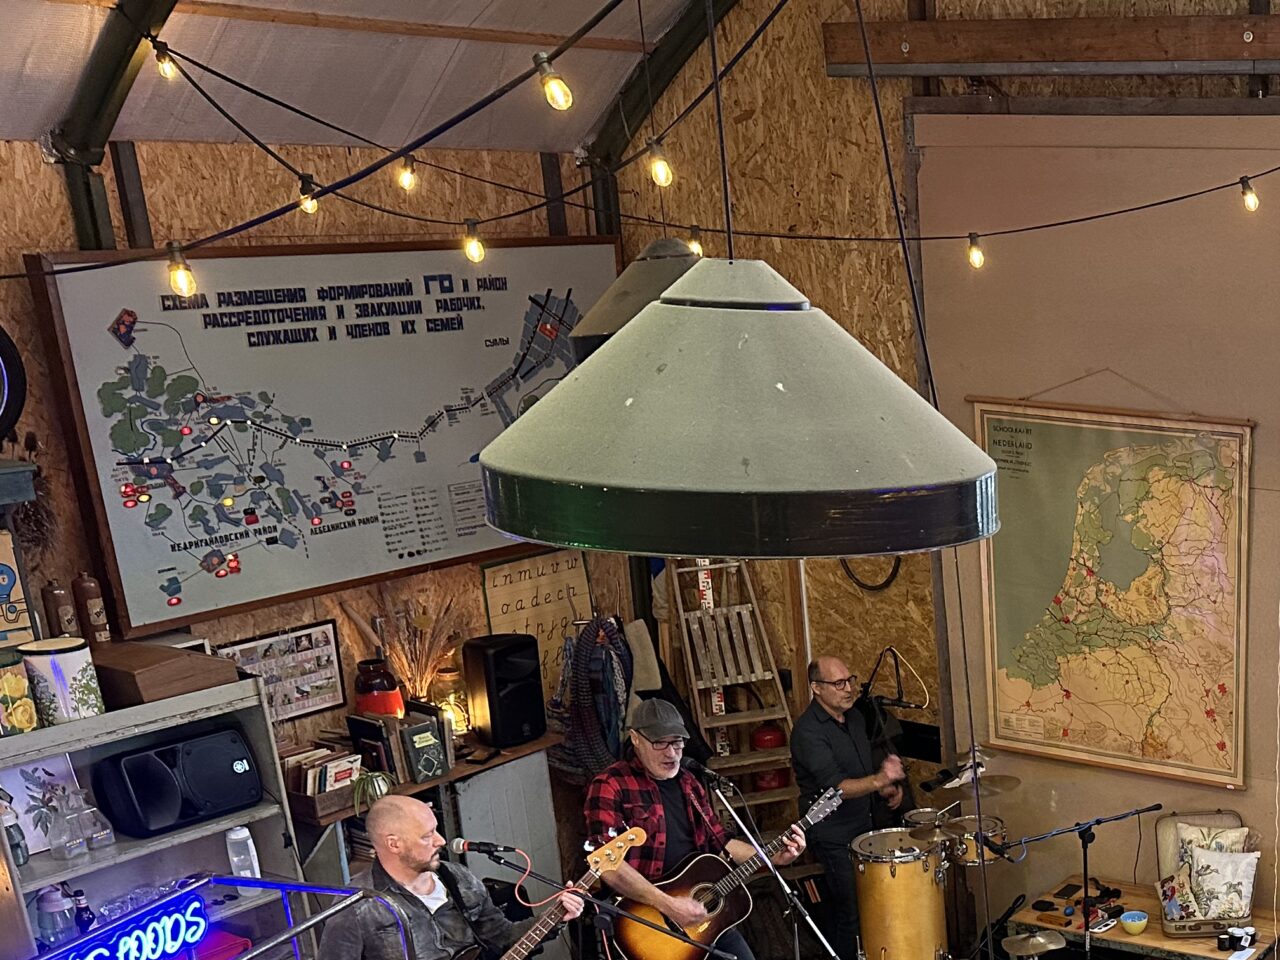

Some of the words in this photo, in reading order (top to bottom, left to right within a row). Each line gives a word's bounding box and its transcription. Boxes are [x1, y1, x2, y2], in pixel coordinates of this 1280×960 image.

[160, 294, 209, 312] СХЕМА
[217, 287, 307, 308] РАЗМЕЩЕНИЯ
[317, 278, 413, 301] ФОРМИРОВАНИЙ
[462, 279, 469, 292] И
[477, 274, 507, 292] РАЙОН
[202, 305, 327, 329] РАССРЕДОТОЧЕНИЯ
[336, 304, 345, 320] И
[354, 299, 423, 319] ЭВАКУАЦИИ
[247, 327, 319, 348] СЛУЖАЩИХ
[328, 325, 337, 341] И
[345, 321, 390, 339] ЧЛЕНОВ
[401, 319, 416, 335] ИХ
[426, 313, 464, 332] СЕМЕЙ
